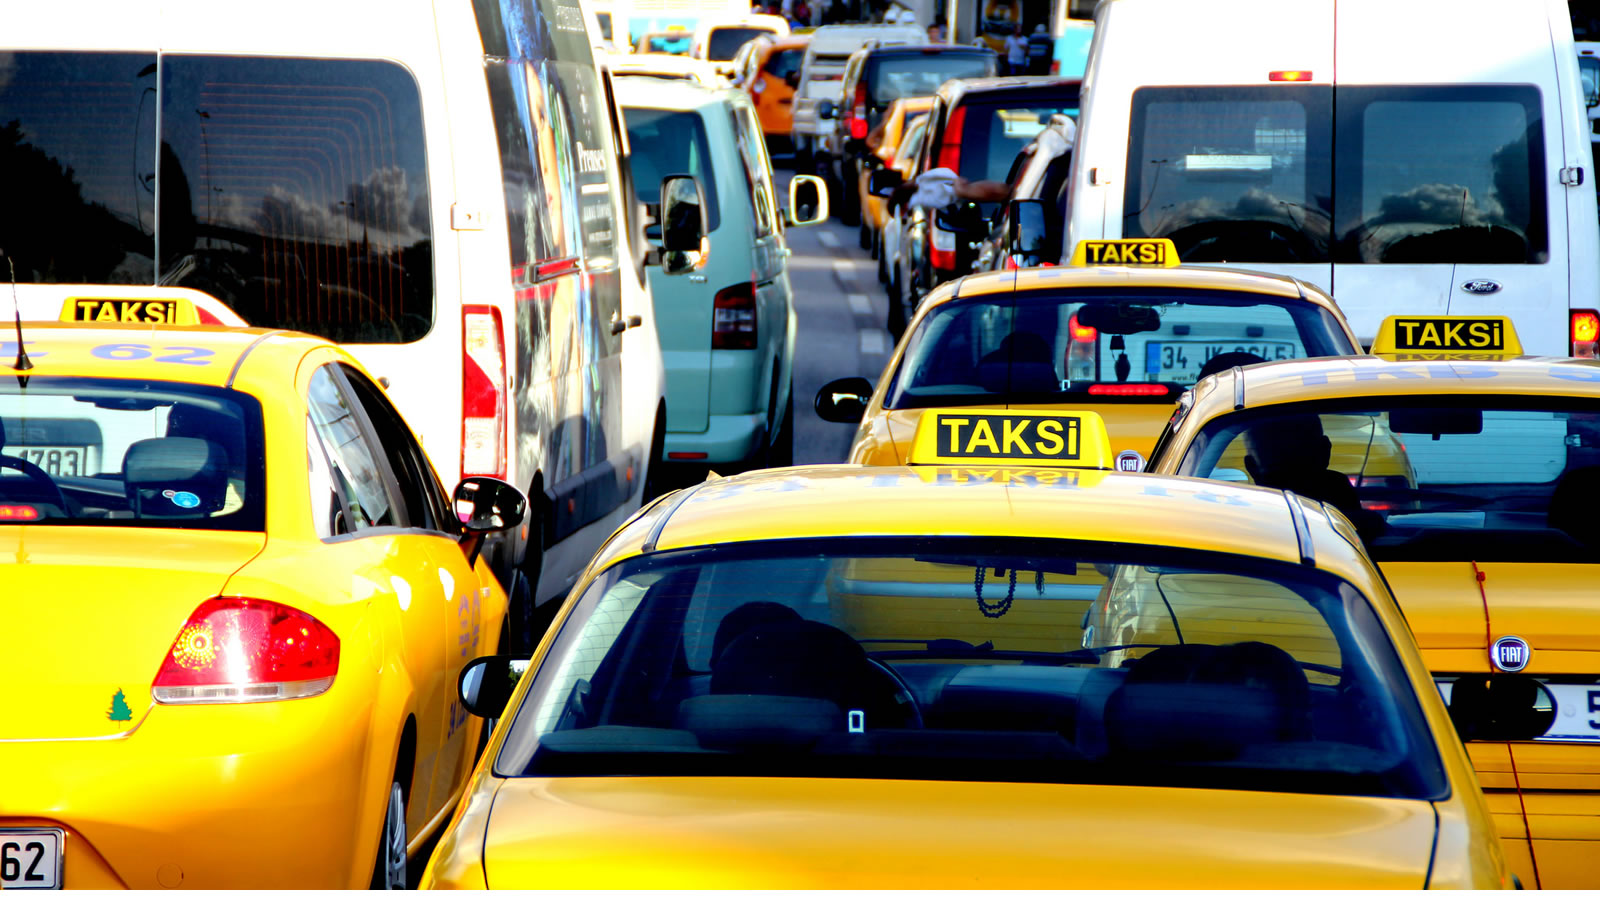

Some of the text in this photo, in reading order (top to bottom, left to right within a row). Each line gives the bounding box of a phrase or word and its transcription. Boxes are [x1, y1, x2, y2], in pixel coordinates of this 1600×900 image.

[1087, 244, 1163, 262] TAKSi
[1470, 281, 1494, 292] Ford
[77, 301, 175, 324] TAKSi
[1398, 321, 1500, 347] TAKSi
[90, 343, 216, 366] 62
[1162, 346, 1188, 369] 34
[1234, 346, 1287, 361] 45
[940, 418, 1079, 456] TAKSi
[1122, 459, 1137, 471] FIAT
[1501, 646, 1522, 663] FIAT
[0, 841, 45, 882] 62
